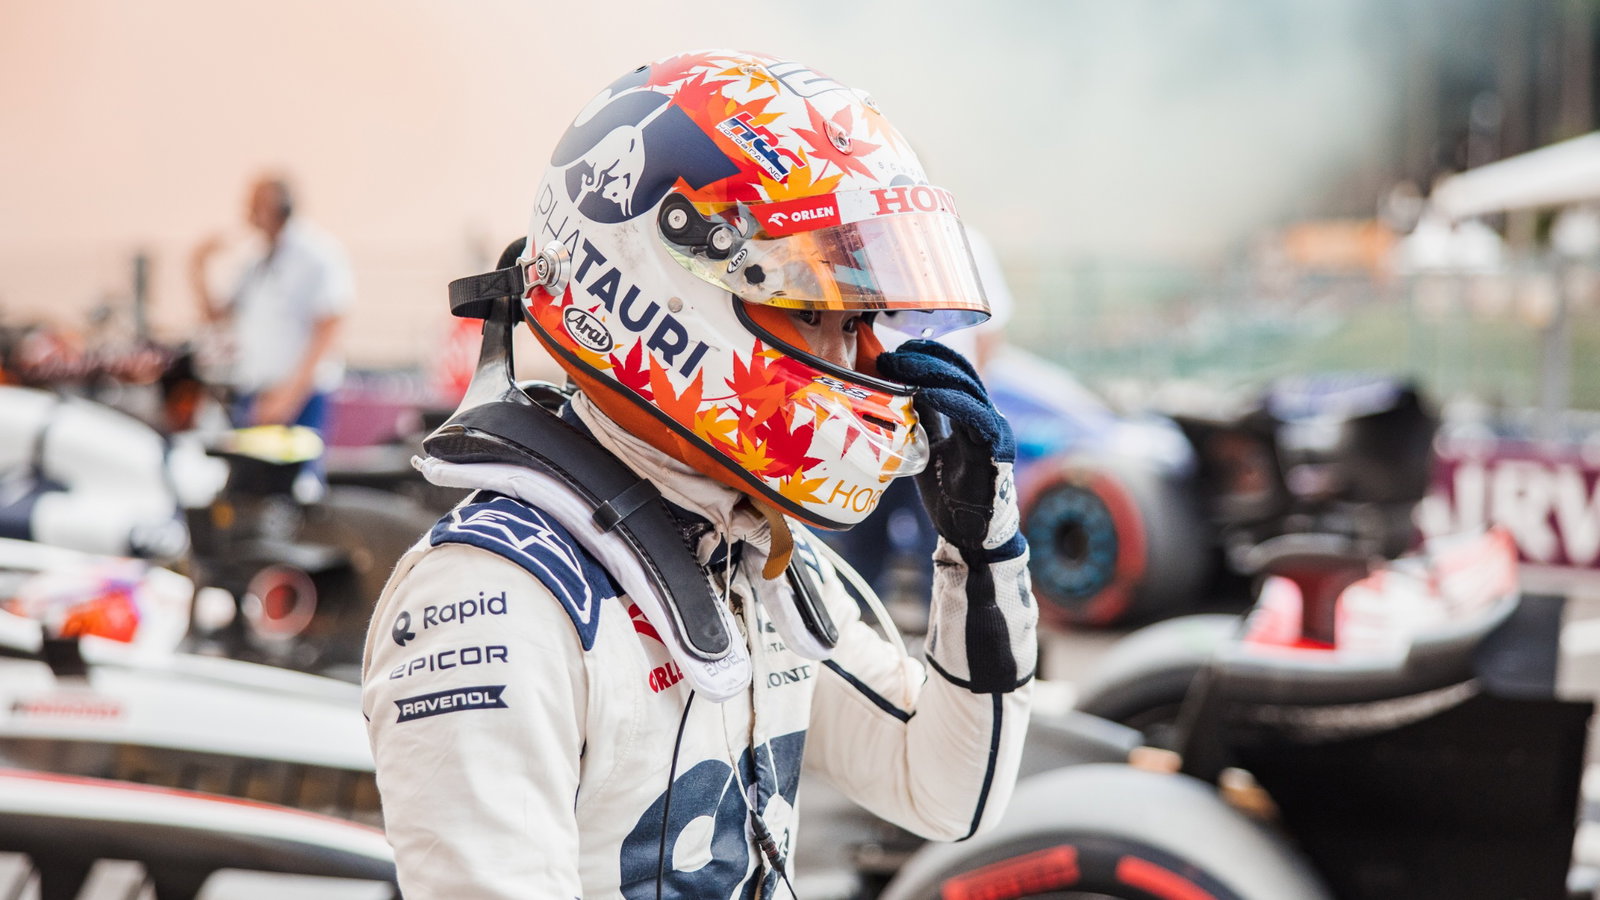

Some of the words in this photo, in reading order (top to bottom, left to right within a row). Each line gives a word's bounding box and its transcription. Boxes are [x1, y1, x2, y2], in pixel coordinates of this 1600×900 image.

[791, 206, 834, 222] ORLEN
[566, 314, 609, 346] Arai
[423, 591, 507, 629] Rapid
[402, 692, 497, 716] RAVENOL
